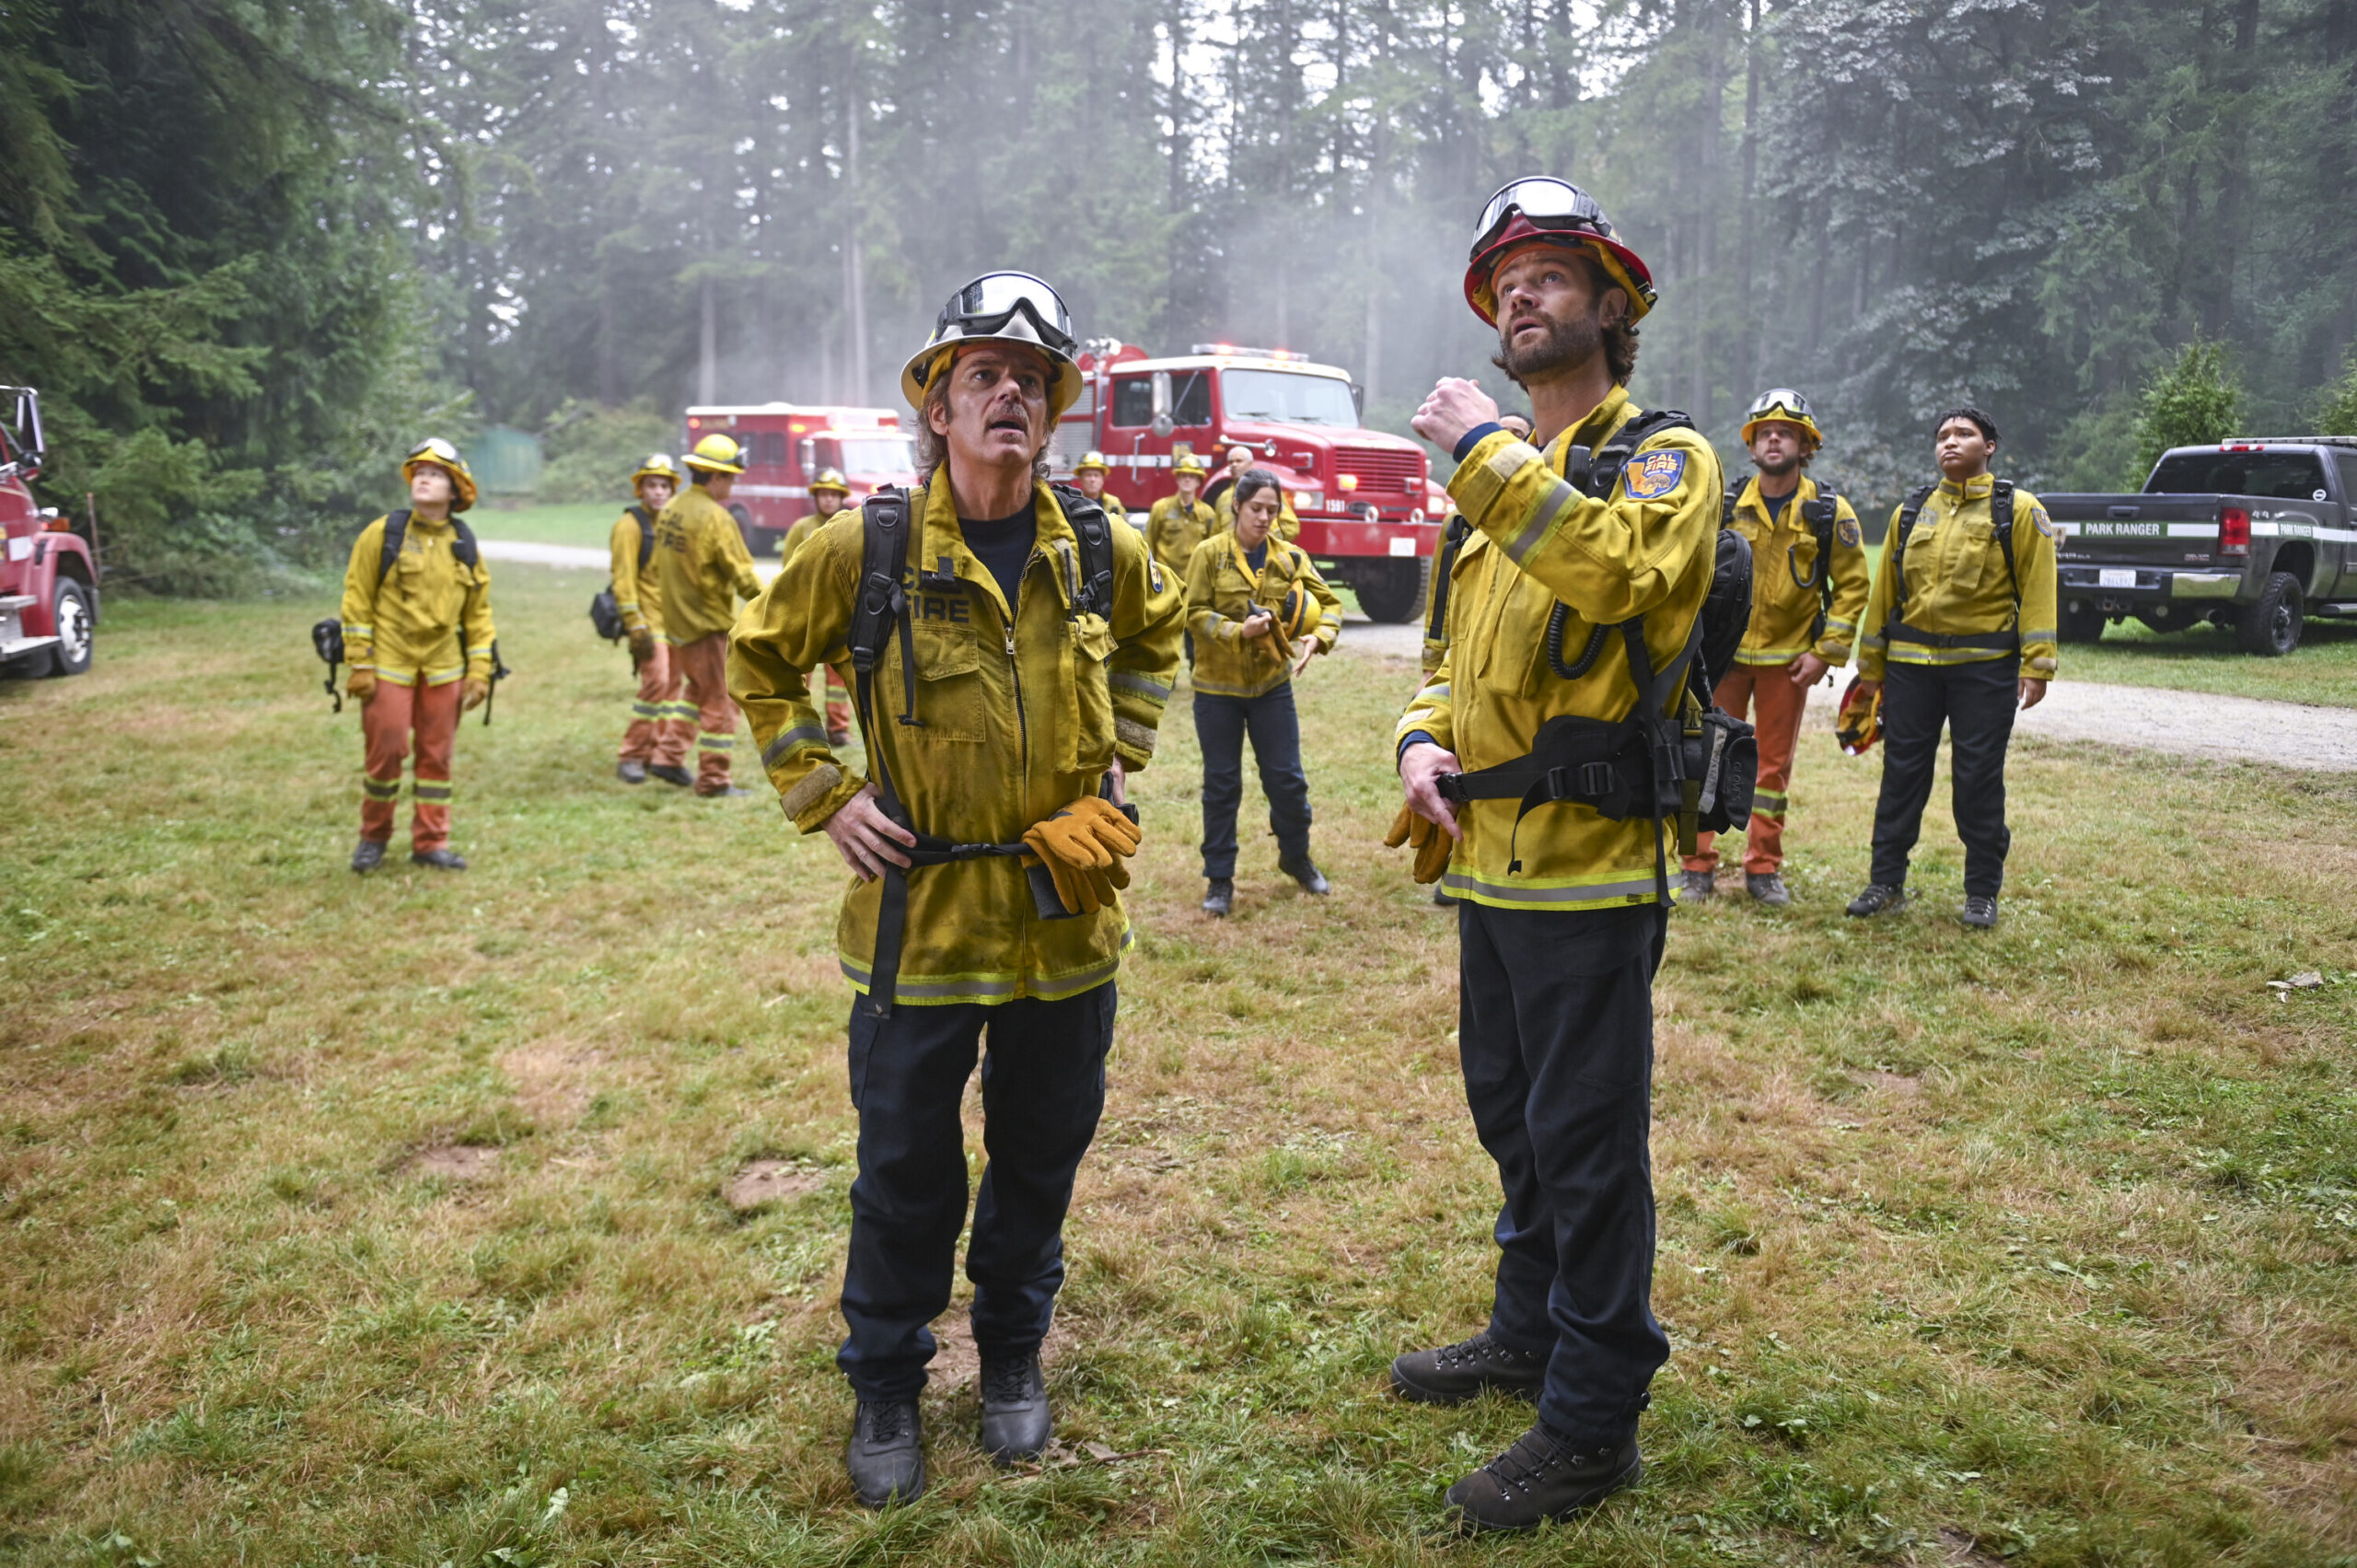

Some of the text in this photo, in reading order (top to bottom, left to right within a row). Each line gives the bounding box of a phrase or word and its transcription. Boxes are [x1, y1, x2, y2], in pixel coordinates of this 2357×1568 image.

[1646, 454, 1677, 466] CAL
[1643, 461, 1678, 474] FIRE
[2252, 509, 2270, 518] 44
[2085, 523, 2160, 536] PARK RANGER
[2280, 523, 2312, 537] PARK RANGER
